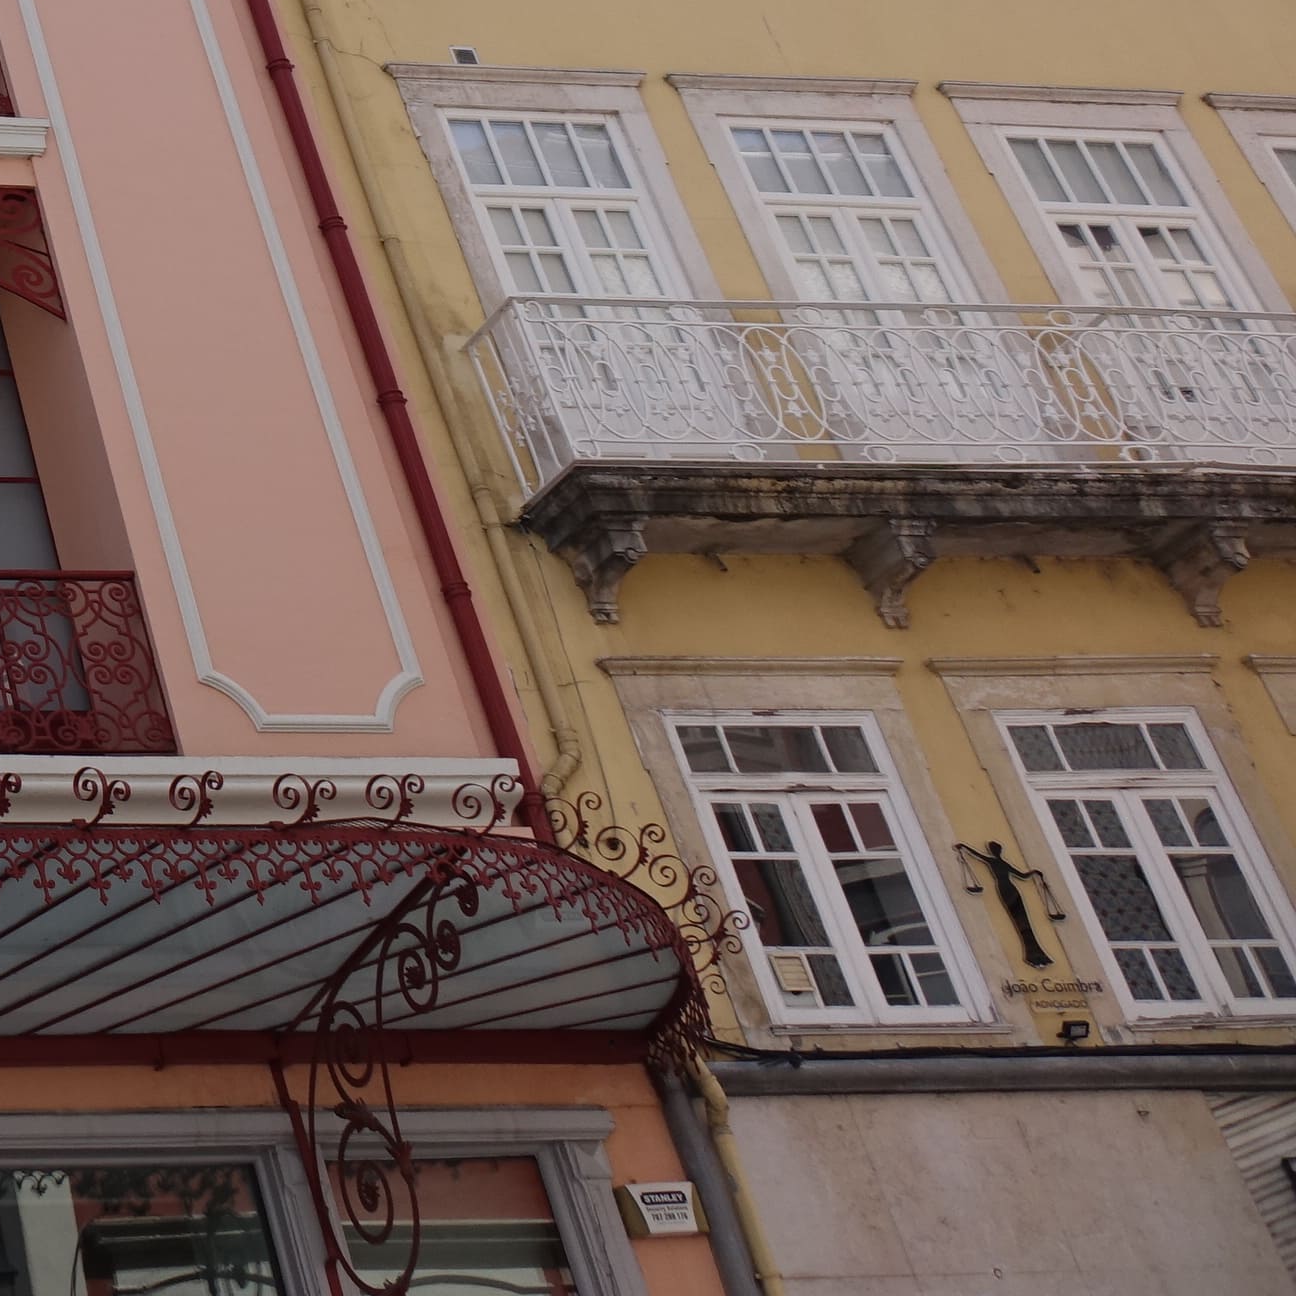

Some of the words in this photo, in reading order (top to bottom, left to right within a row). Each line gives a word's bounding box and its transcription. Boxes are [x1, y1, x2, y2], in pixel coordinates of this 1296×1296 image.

[1002, 979, 1038, 997] João
[1041, 978, 1103, 993] Coimbra
[642, 1193, 684, 1203] STANLEY
